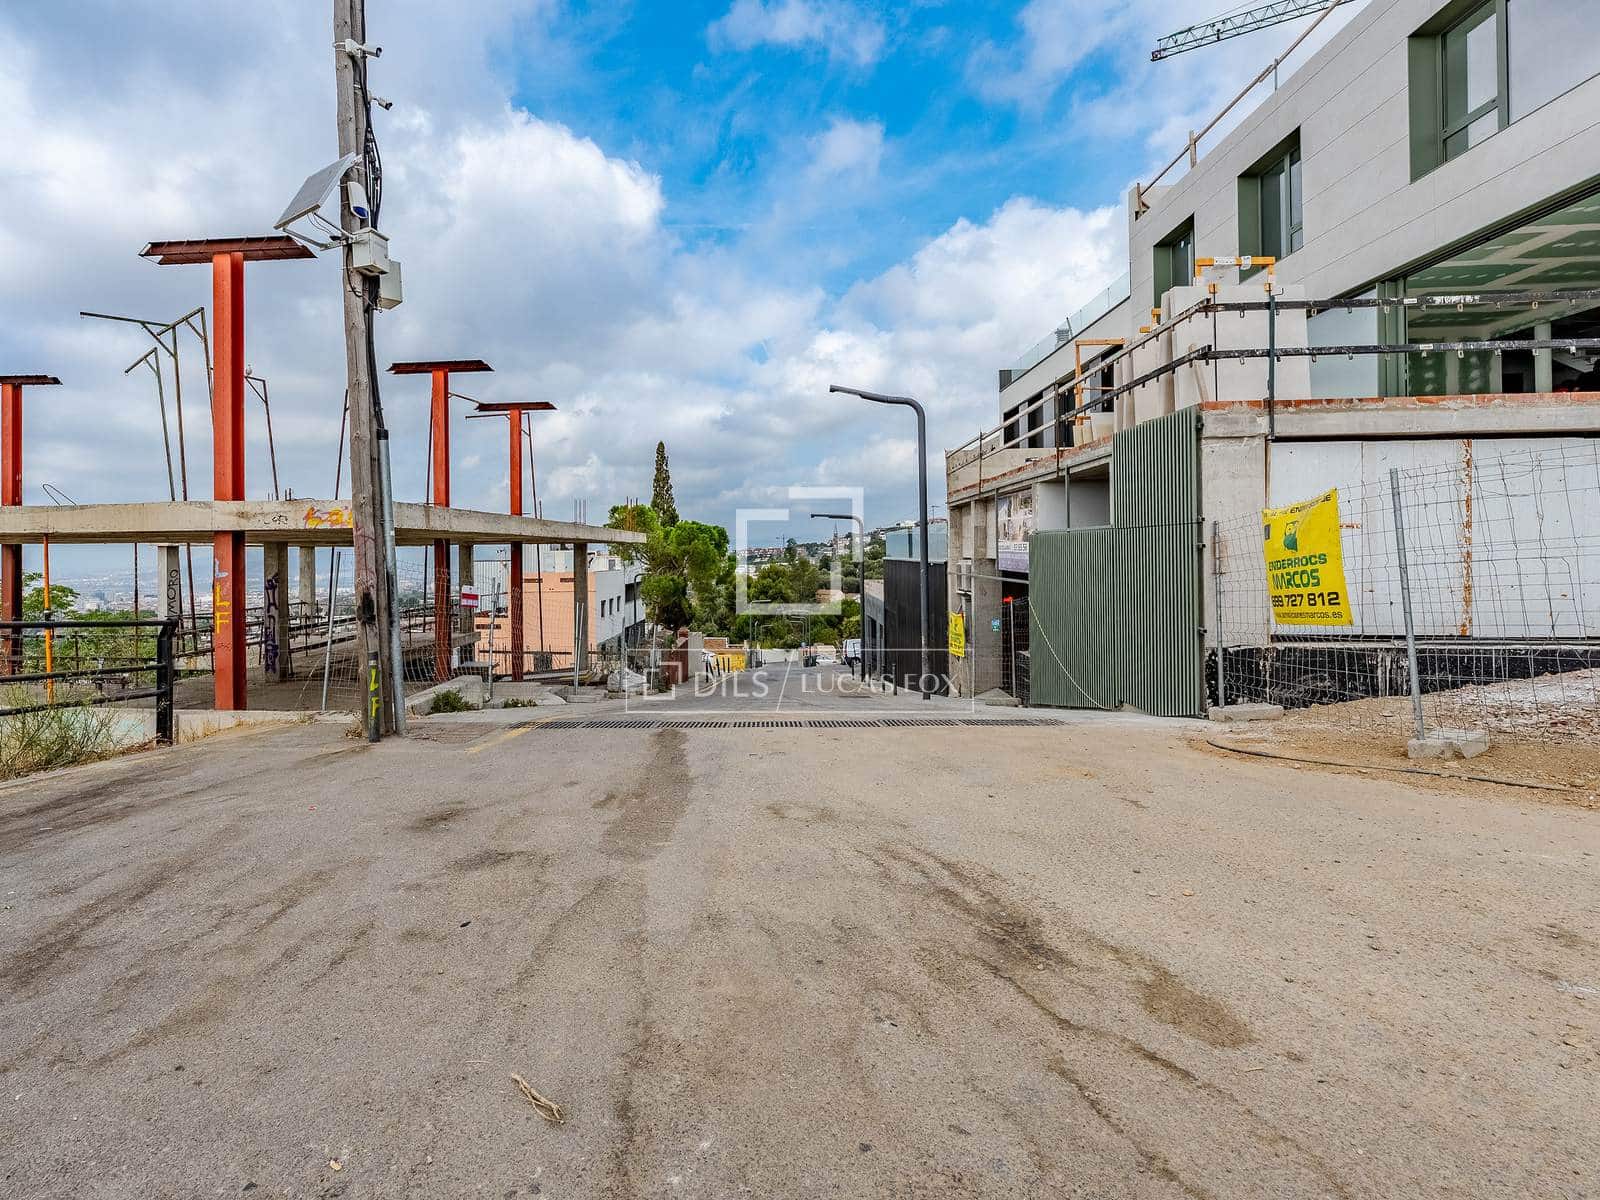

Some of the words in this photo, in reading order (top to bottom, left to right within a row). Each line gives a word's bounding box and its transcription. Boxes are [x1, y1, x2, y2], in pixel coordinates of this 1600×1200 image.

[1272, 568, 1320, 590] MARCOS
[1284, 594, 1304, 607] 727
[1307, 592, 1341, 606] 812
